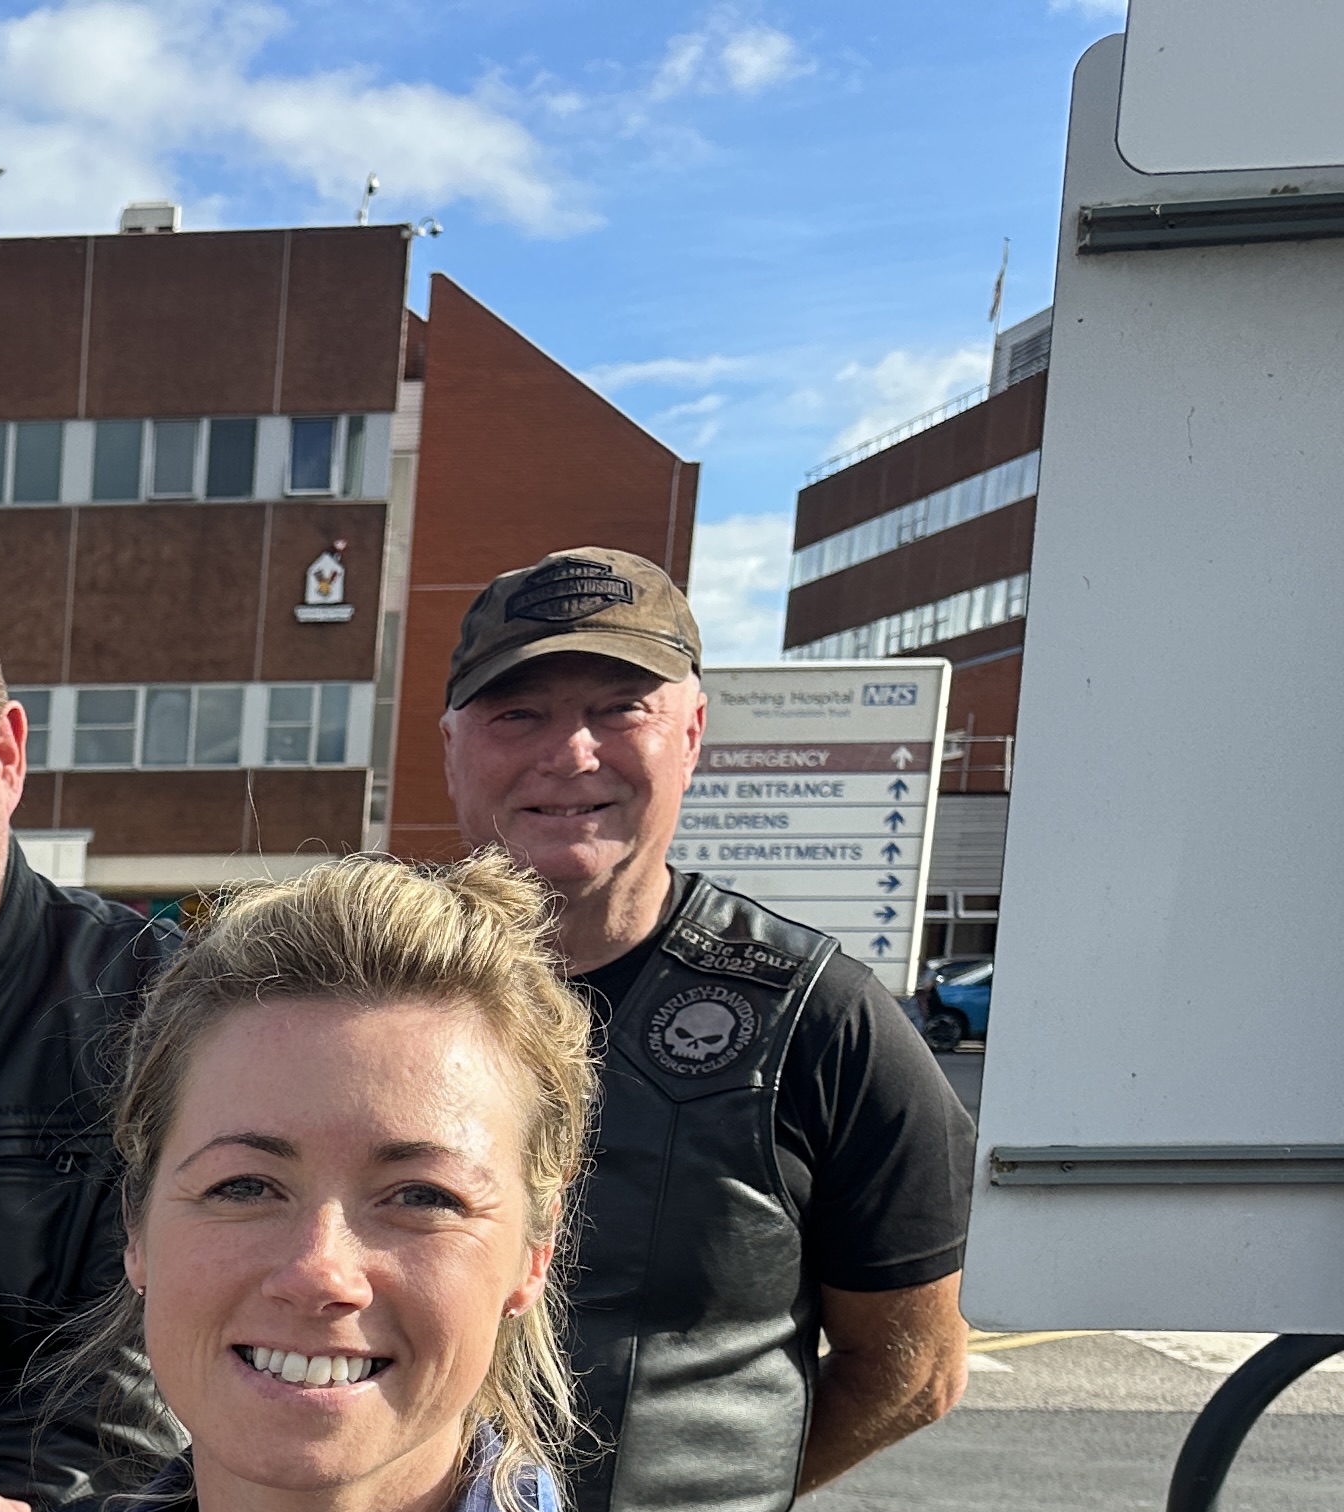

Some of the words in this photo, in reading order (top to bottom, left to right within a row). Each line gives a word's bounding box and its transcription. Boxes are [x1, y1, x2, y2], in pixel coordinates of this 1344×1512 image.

[719, 690, 784, 708] Teaching
[790, 688, 854, 707] Hospital
[864, 684, 916, 706] NHS
[709, 750, 830, 768] EMERGENCY
[736, 781, 844, 798] ENTRANCE
[681, 811, 790, 830] CHILDRENS
[697, 843, 710, 861] &
[718, 843, 863, 861] DEPARTMENTS
[699, 953, 756, 974] 2022
[743, 944, 798, 970] tour
